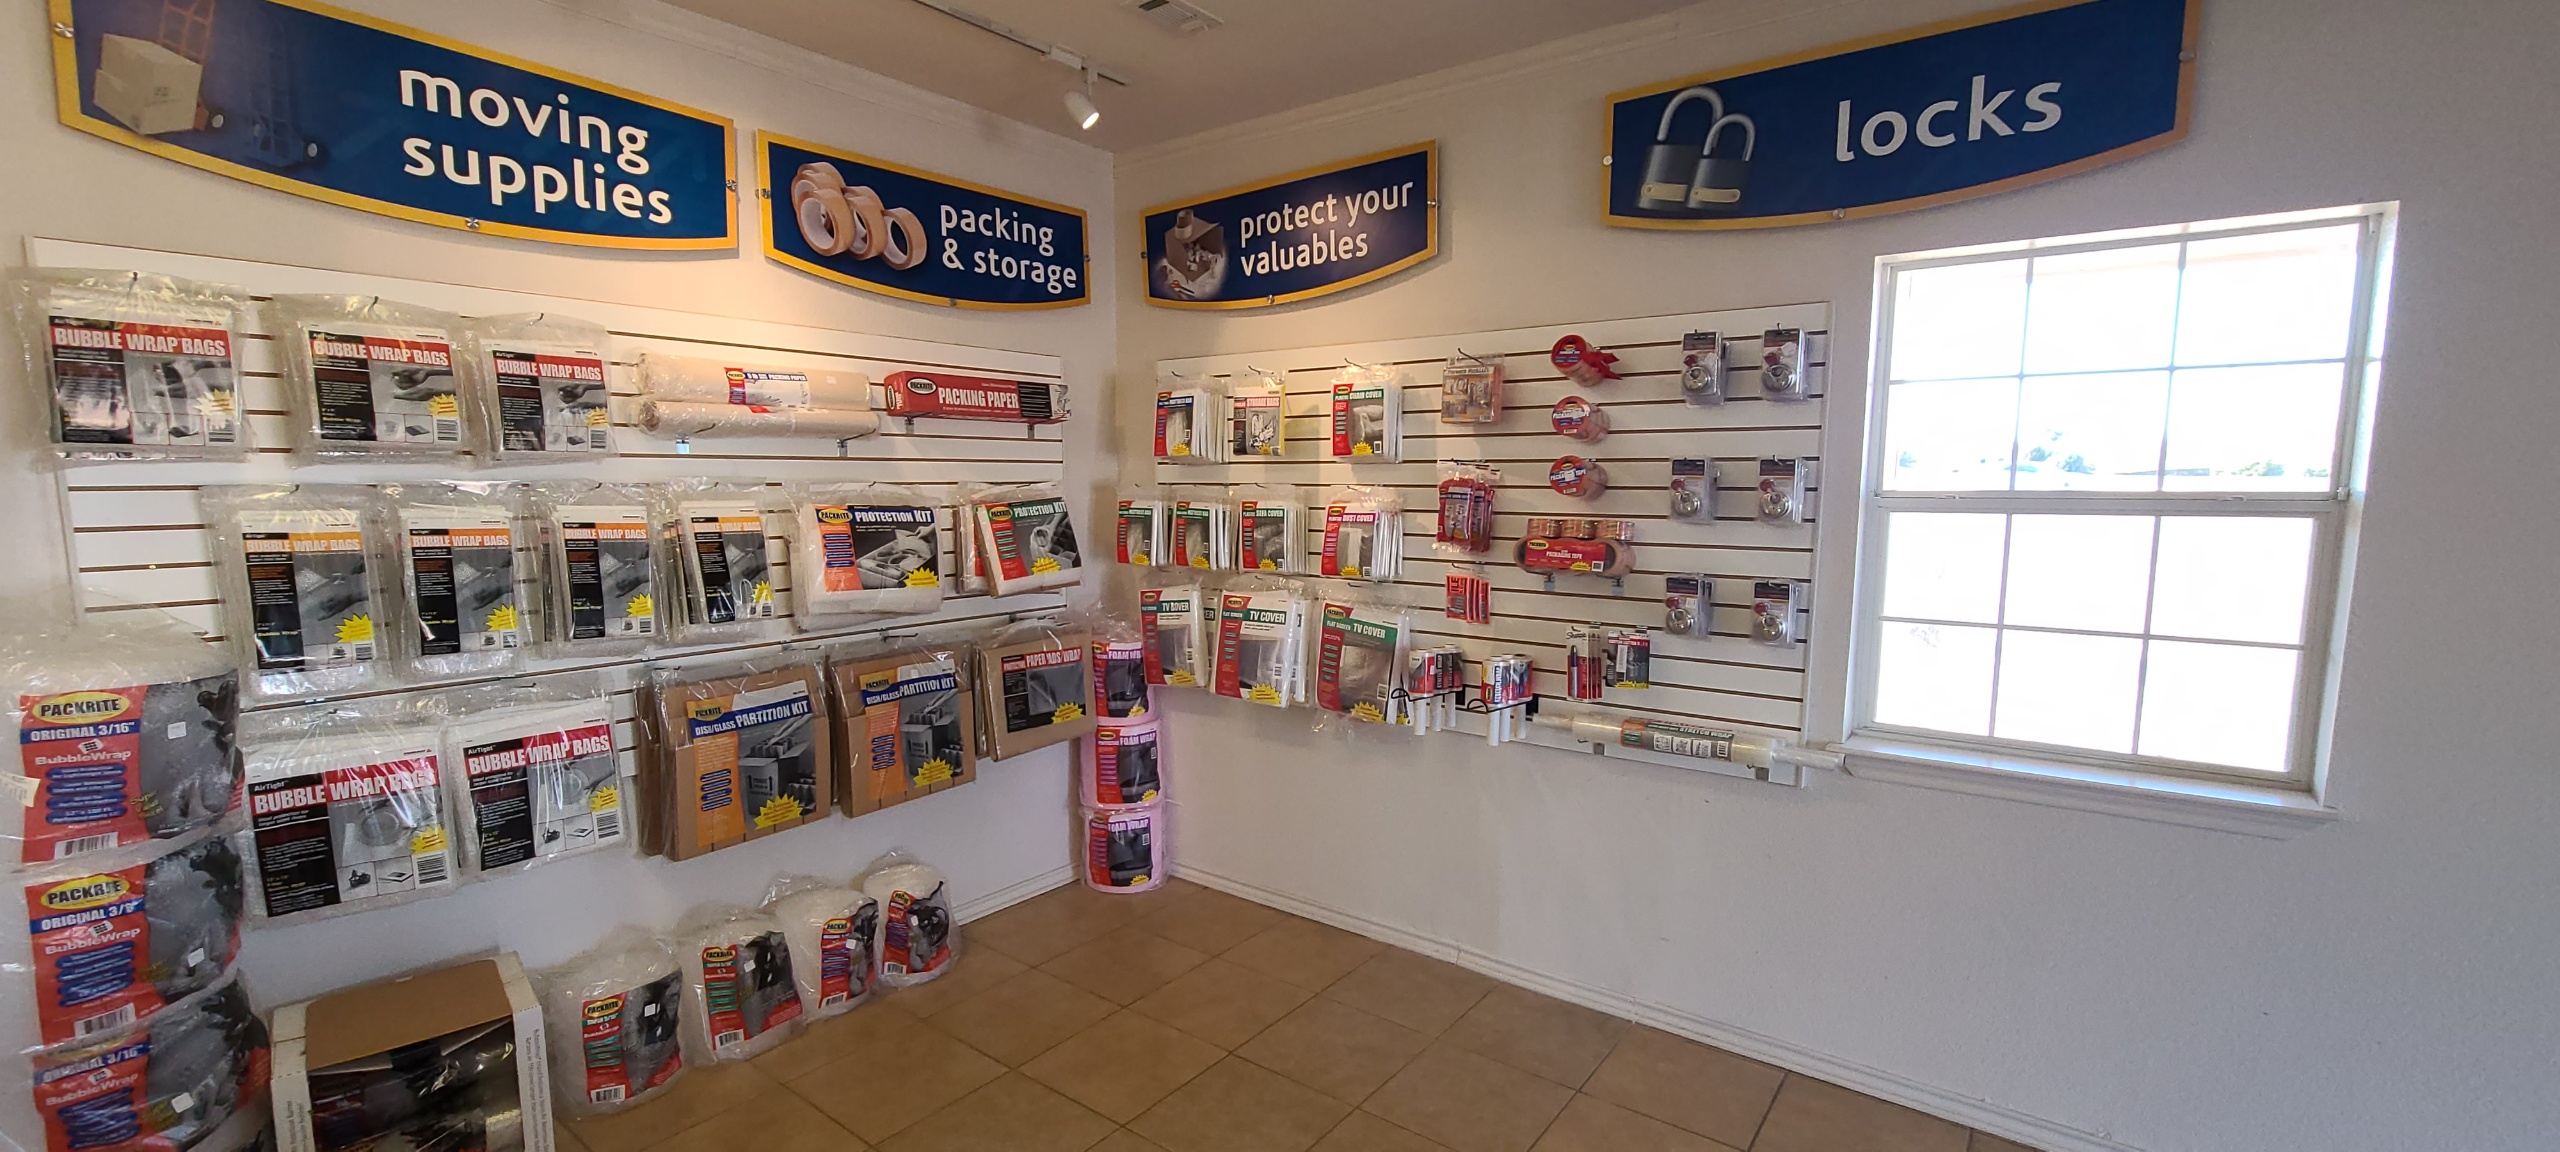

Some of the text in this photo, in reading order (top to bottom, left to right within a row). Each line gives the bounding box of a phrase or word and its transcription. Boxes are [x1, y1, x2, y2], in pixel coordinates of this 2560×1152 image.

[400, 69, 649, 175] moving
[1836, 74, 2062, 163] locks
[402, 137, 673, 224] supplies
[1240, 181, 1412, 247] protect your
[940, 204, 1054, 257] packing
[1240, 231, 1367, 278] valuables
[943, 240, 1077, 294] & storage
[55, 327, 226, 358] BUBBLE WRAP BAGS
[496, 359, 602, 380] BUBBLE WRAP BAGS
[937, 387, 986, 407] PACKING
[987, 391, 1019, 409] PAPER
[854, 509, 931, 522] PROTECTION KIT
[1013, 504, 1054, 518] PROTECTION
[1267, 509, 1284, 517] COVER
[1356, 514, 1374, 522] COVER
[1161, 602, 1171, 612] TV
[1249, 610, 1260, 622] TV
[1260, 611, 1286, 624] COVER
[1353, 622, 1364, 633] TV
[1363, 625, 1386, 639] COVER
[1108, 650, 1129, 660] FOAM
[899, 680, 941, 698] PARTITION
[941, 676, 955, 690] KIT
[41, 697, 121, 717] PACKRITE
[735, 705, 792, 729] PARTITION
[792, 700, 809, 716] KIT
[31, 721, 135, 742] ORIGINAL 3/16"
[1119, 736, 1139, 746] FOAM
[1679, 727, 1733, 739] STRETCH WRAP
[35, 750, 132, 766] BubbleWrap
[468, 735, 610, 775] BUBBLE WRAP BAGS
[253, 784, 327, 815] BUBBLE
[329, 775, 388, 801] WRAP
[1107, 821, 1126, 832] FOAM
[41, 908, 105, 931] ORIGINAL
[46, 926, 141, 956] BubbleWrap
[46, 1073, 139, 1106] BubbleWrap
